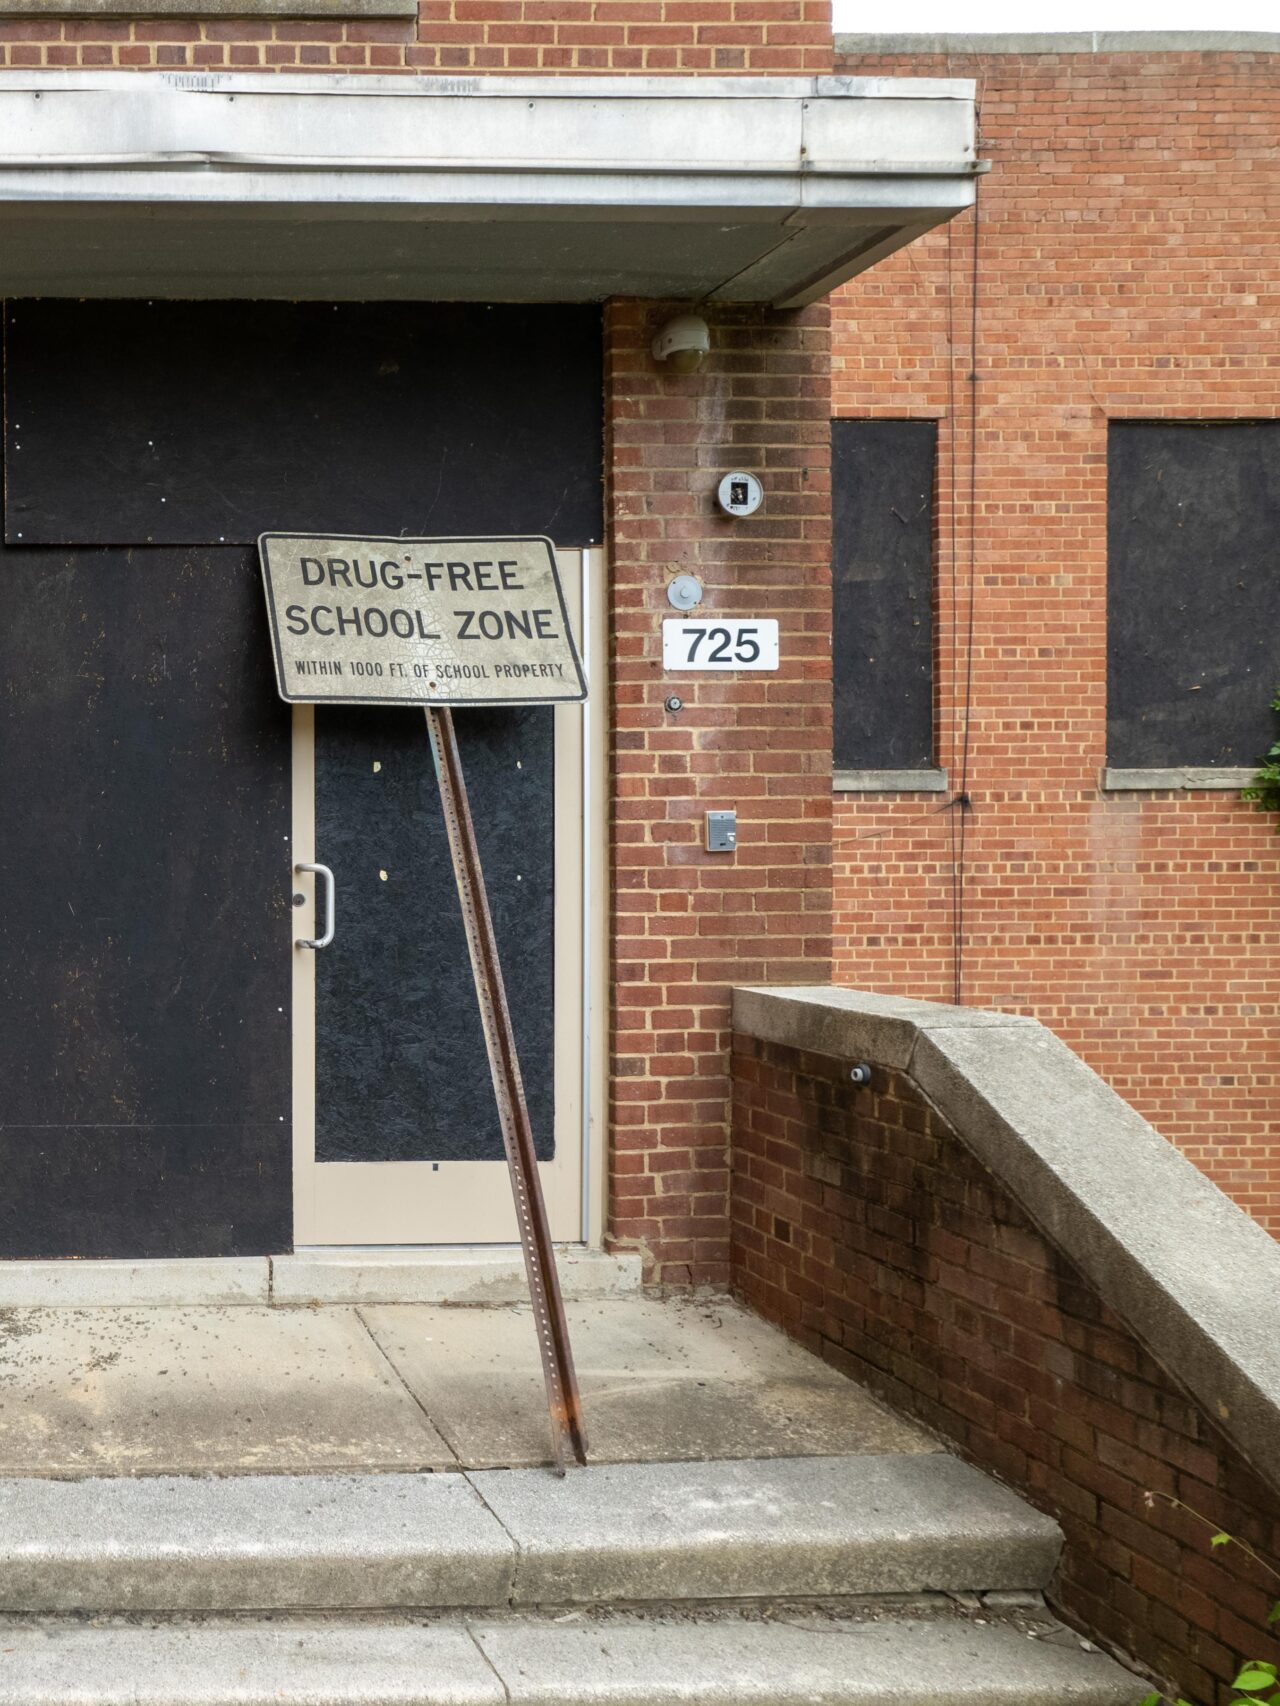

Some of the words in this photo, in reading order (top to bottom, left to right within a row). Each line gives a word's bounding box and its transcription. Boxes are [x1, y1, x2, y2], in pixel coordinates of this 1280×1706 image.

[300, 557, 524, 591] DRUG-FREE
[285, 605, 440, 639] SCHOOL
[453, 609, 559, 640] ZONE
[682, 628, 760, 662] 725
[295, 661, 342, 675] WITHIN
[350, 662, 383, 676] 1000
[389, 663, 408, 677] FT.
[414, 664, 429, 677] OF
[436, 664, 489, 678] SCHOOL
[495, 663, 563, 677] PROPERTY
